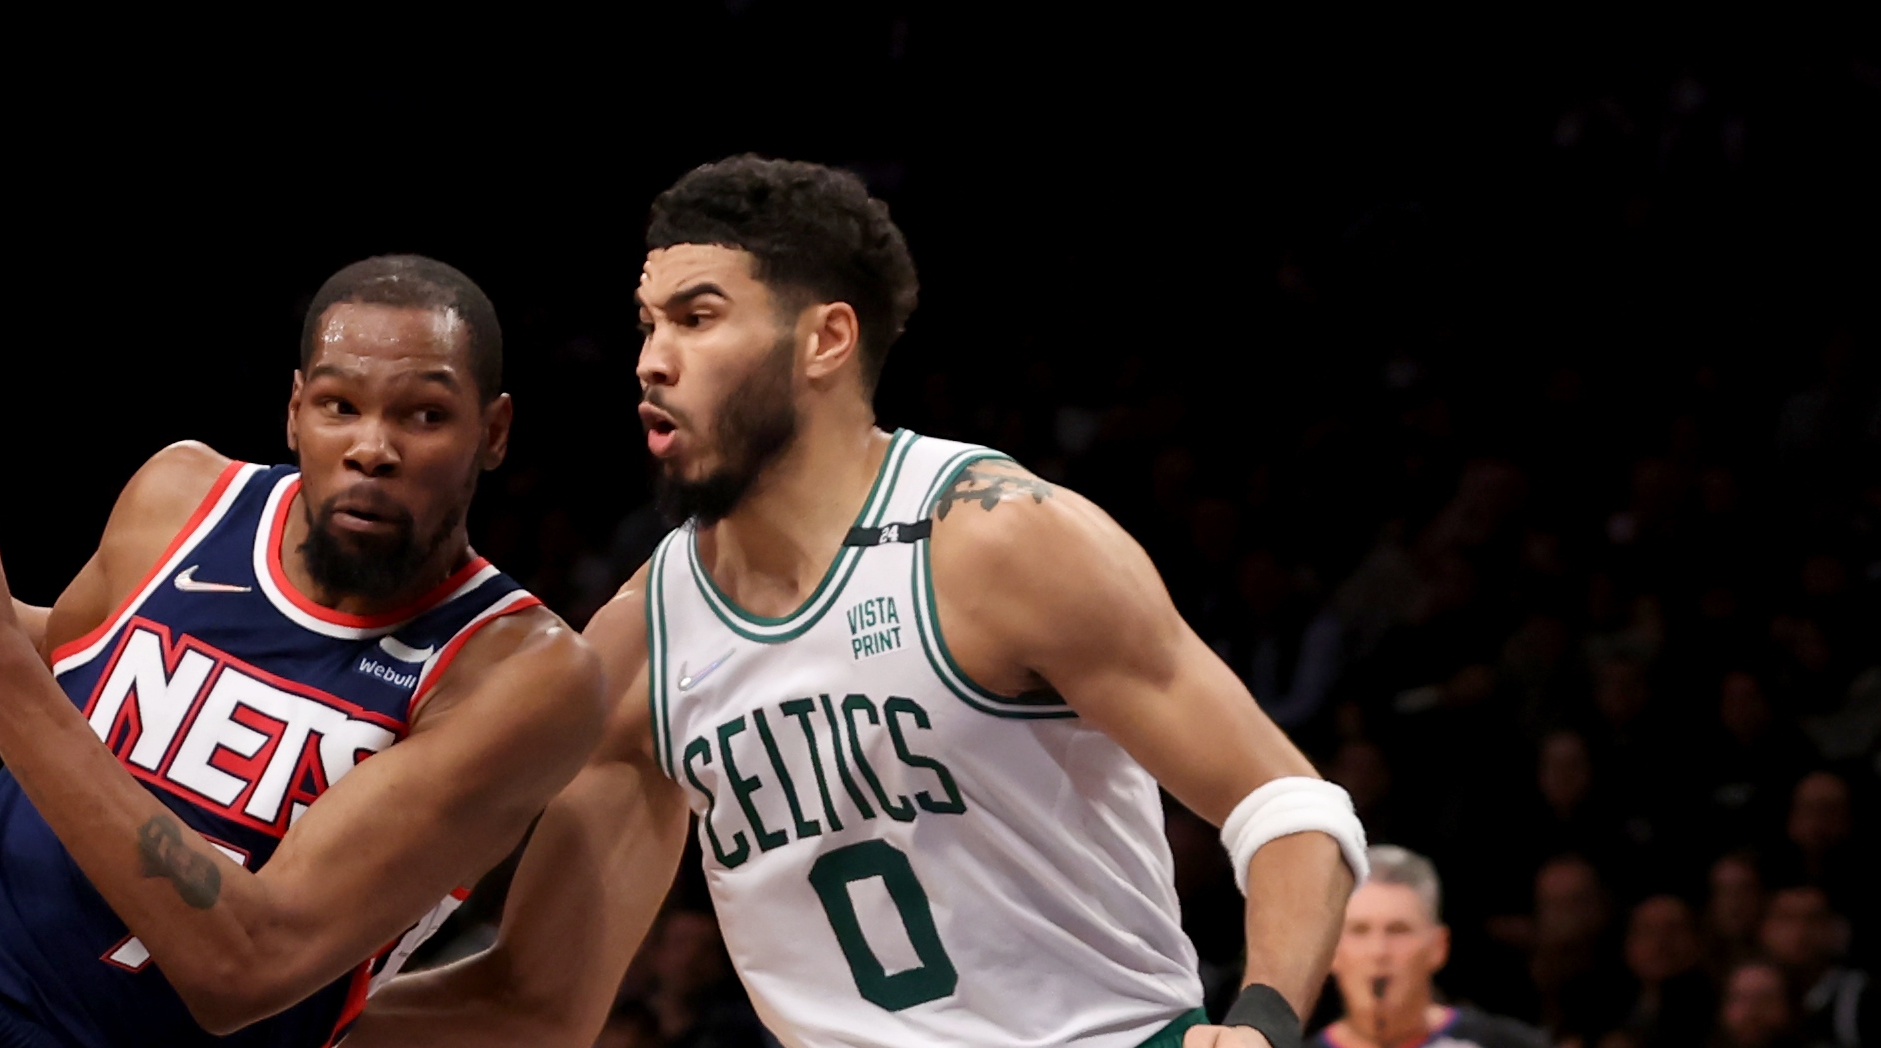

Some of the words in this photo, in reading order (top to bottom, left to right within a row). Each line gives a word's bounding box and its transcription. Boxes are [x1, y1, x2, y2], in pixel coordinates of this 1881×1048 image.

[878, 525, 900, 544] 24
[846, 596, 900, 636] VISTA
[851, 627, 902, 660] PRINT
[359, 657, 417, 689] Webull
[682, 693, 967, 870] CELTICS
[808, 839, 958, 1012] 0
